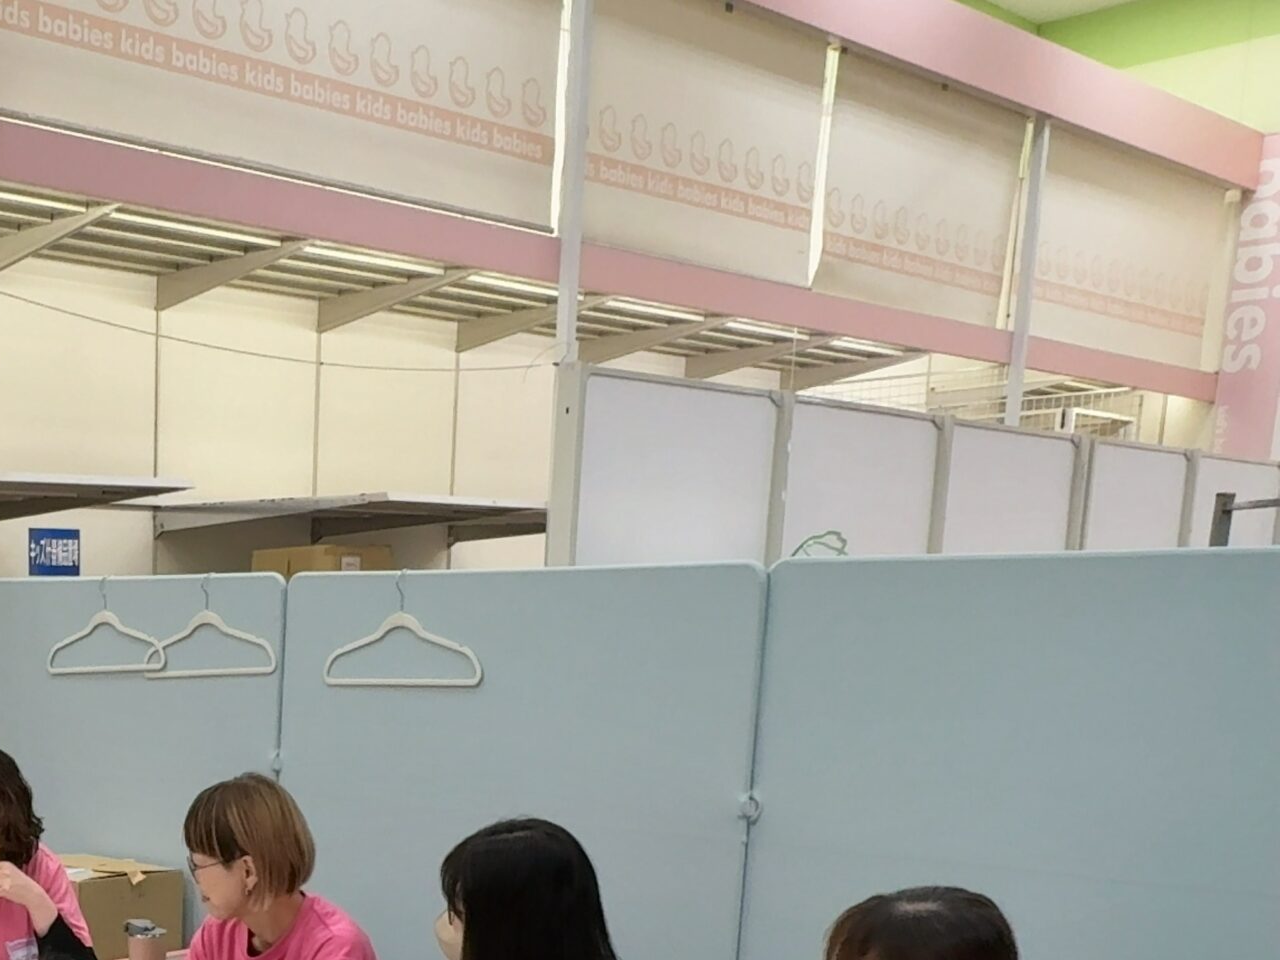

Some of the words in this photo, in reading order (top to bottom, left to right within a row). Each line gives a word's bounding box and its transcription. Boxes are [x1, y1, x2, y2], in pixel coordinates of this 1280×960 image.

[38, 6, 114, 49] babies
[121, 28, 165, 63] kids
[171, 42, 239, 81] babies
[245, 61, 284, 93] kids
[291, 73, 350, 110] babies
[356, 90, 392, 120] kids
[397, 102, 451, 135] babies
[456, 117, 488, 145] kids
[493, 127, 543, 158] babies
[599, 160, 645, 189] babies
